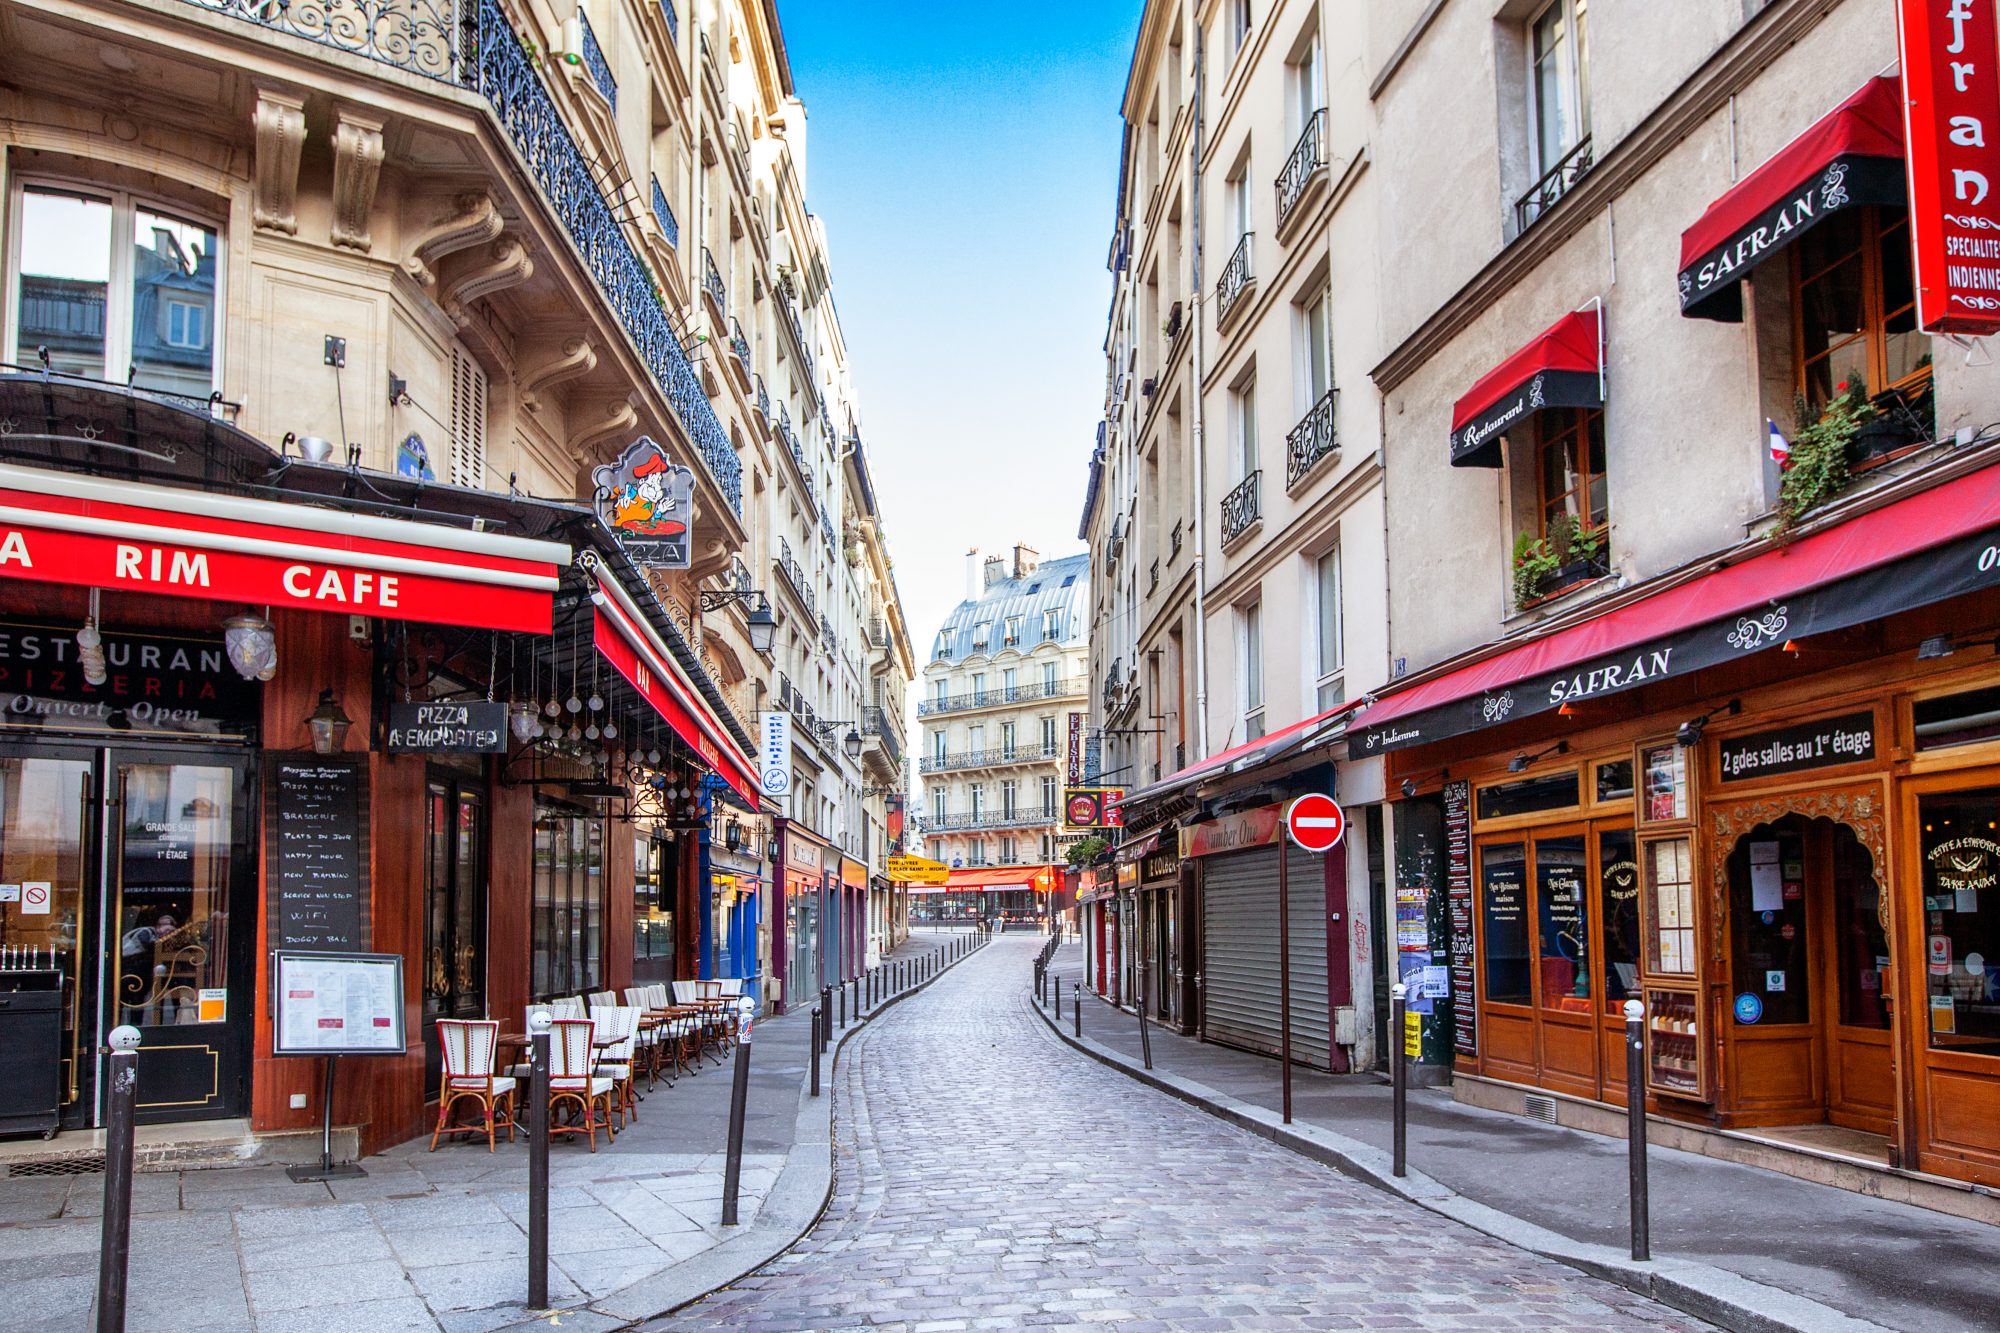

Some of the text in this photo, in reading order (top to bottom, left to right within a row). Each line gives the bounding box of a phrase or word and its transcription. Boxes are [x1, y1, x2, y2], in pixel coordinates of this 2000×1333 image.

[1698, 190, 1814, 290] SAFRAN
[1463, 398, 1523, 447] Restaurant
[115, 544, 210, 587] RIM
[282, 565, 399, 608] CAFE
[636, 660, 650, 695] BAR
[1549, 647, 1673, 704] SAFRAN
[10, 694, 105, 718] Ouvert
[131, 701, 200, 726] Open
[417, 706, 468, 725] PIZZA
[1382, 728, 1420, 746] Indiennes
[1069, 733, 1079, 777] BISTRO
[1722, 729, 1871, 775] 2 gdes salles au 1er étage
[284, 832, 312, 840] PLATS
[1057, 835, 1087, 843] PAELLA
[1240, 819, 1258, 845] One
[285, 852, 313, 860] HAPPY
[1927, 839, 1956, 860] VENTE
[1940, 873, 1998, 891] TAKE AWAY
[285, 935, 348, 944] DOGGY BAG
